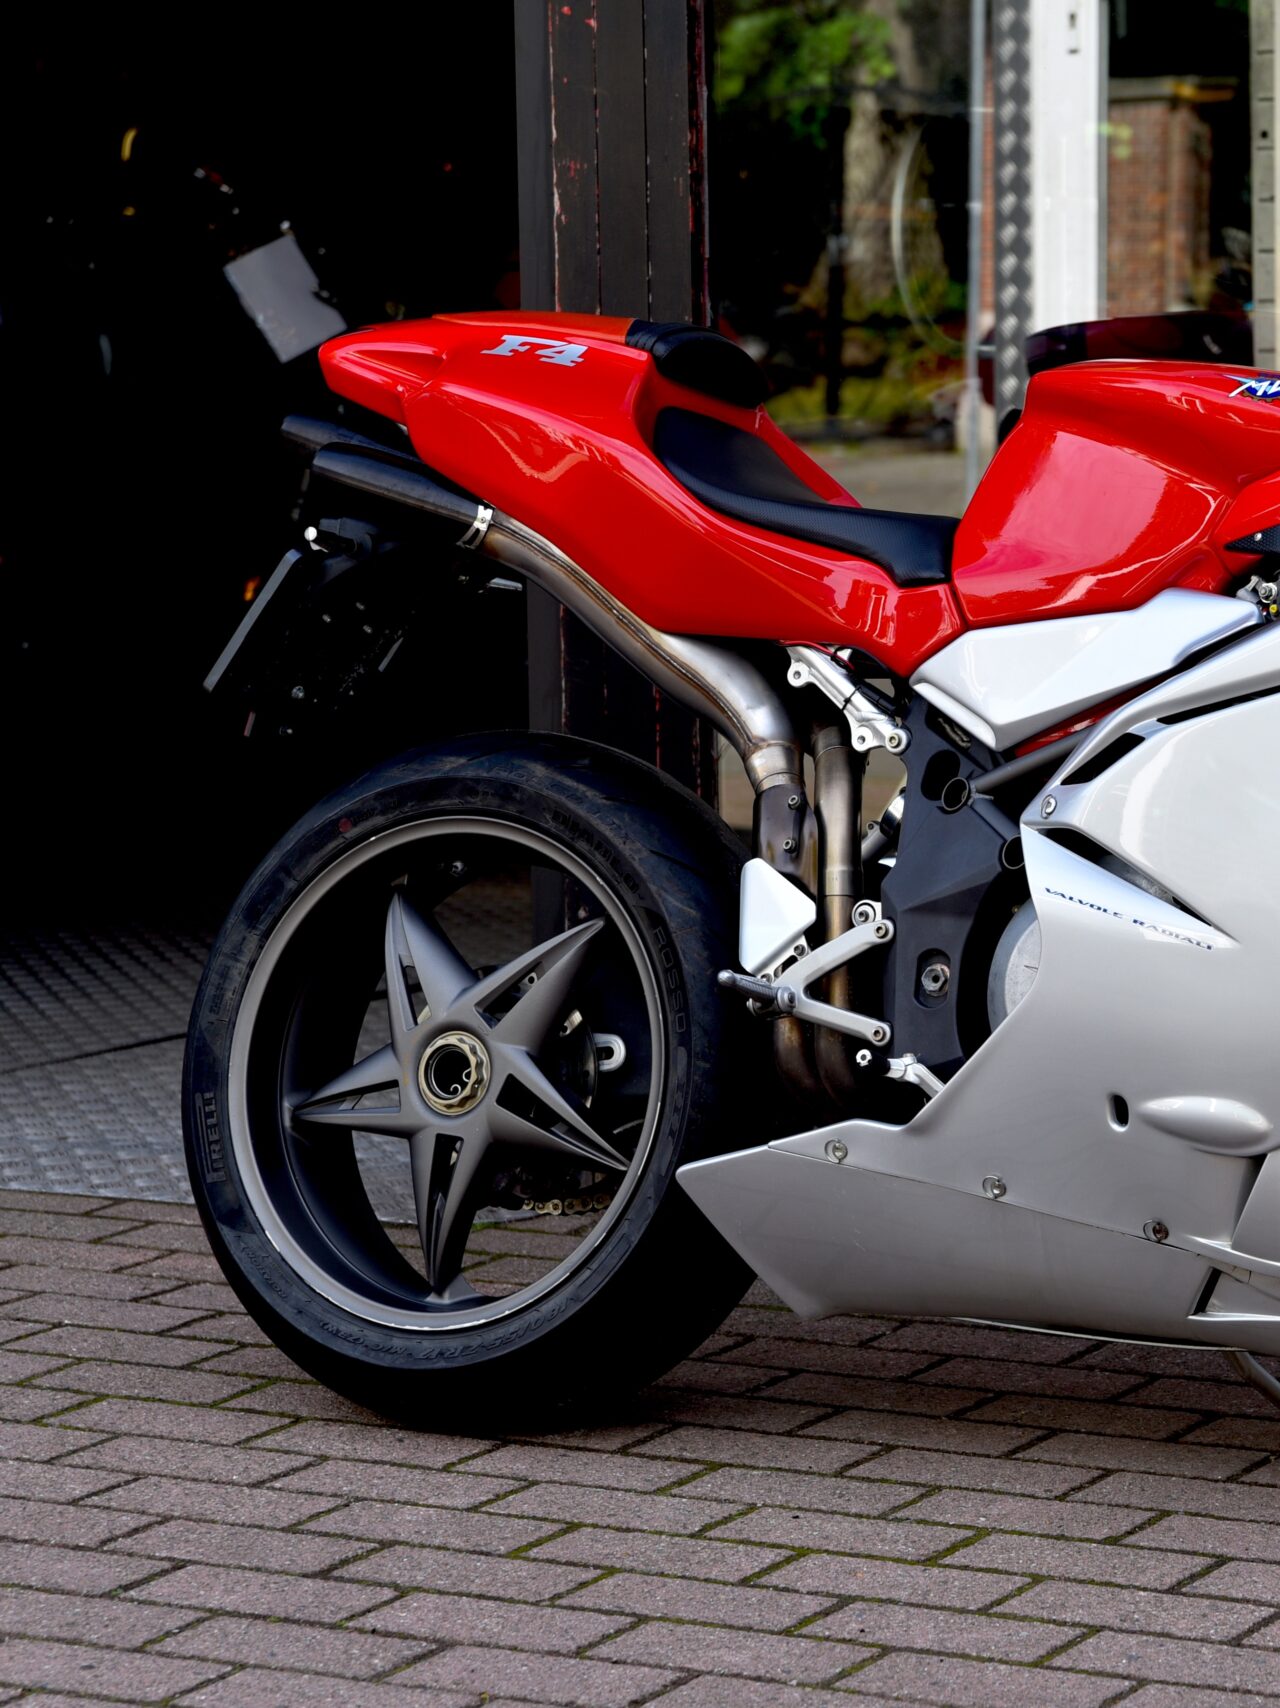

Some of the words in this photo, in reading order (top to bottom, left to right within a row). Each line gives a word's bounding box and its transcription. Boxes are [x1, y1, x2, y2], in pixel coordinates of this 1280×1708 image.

[480, 334, 589, 367] F4
[1044, 887, 1125, 920] VALVOLE
[1132, 918, 1213, 951] RADIALI
[653, 926, 688, 1034] ROSSO
[194, 1092, 227, 1184] PIRELLI
